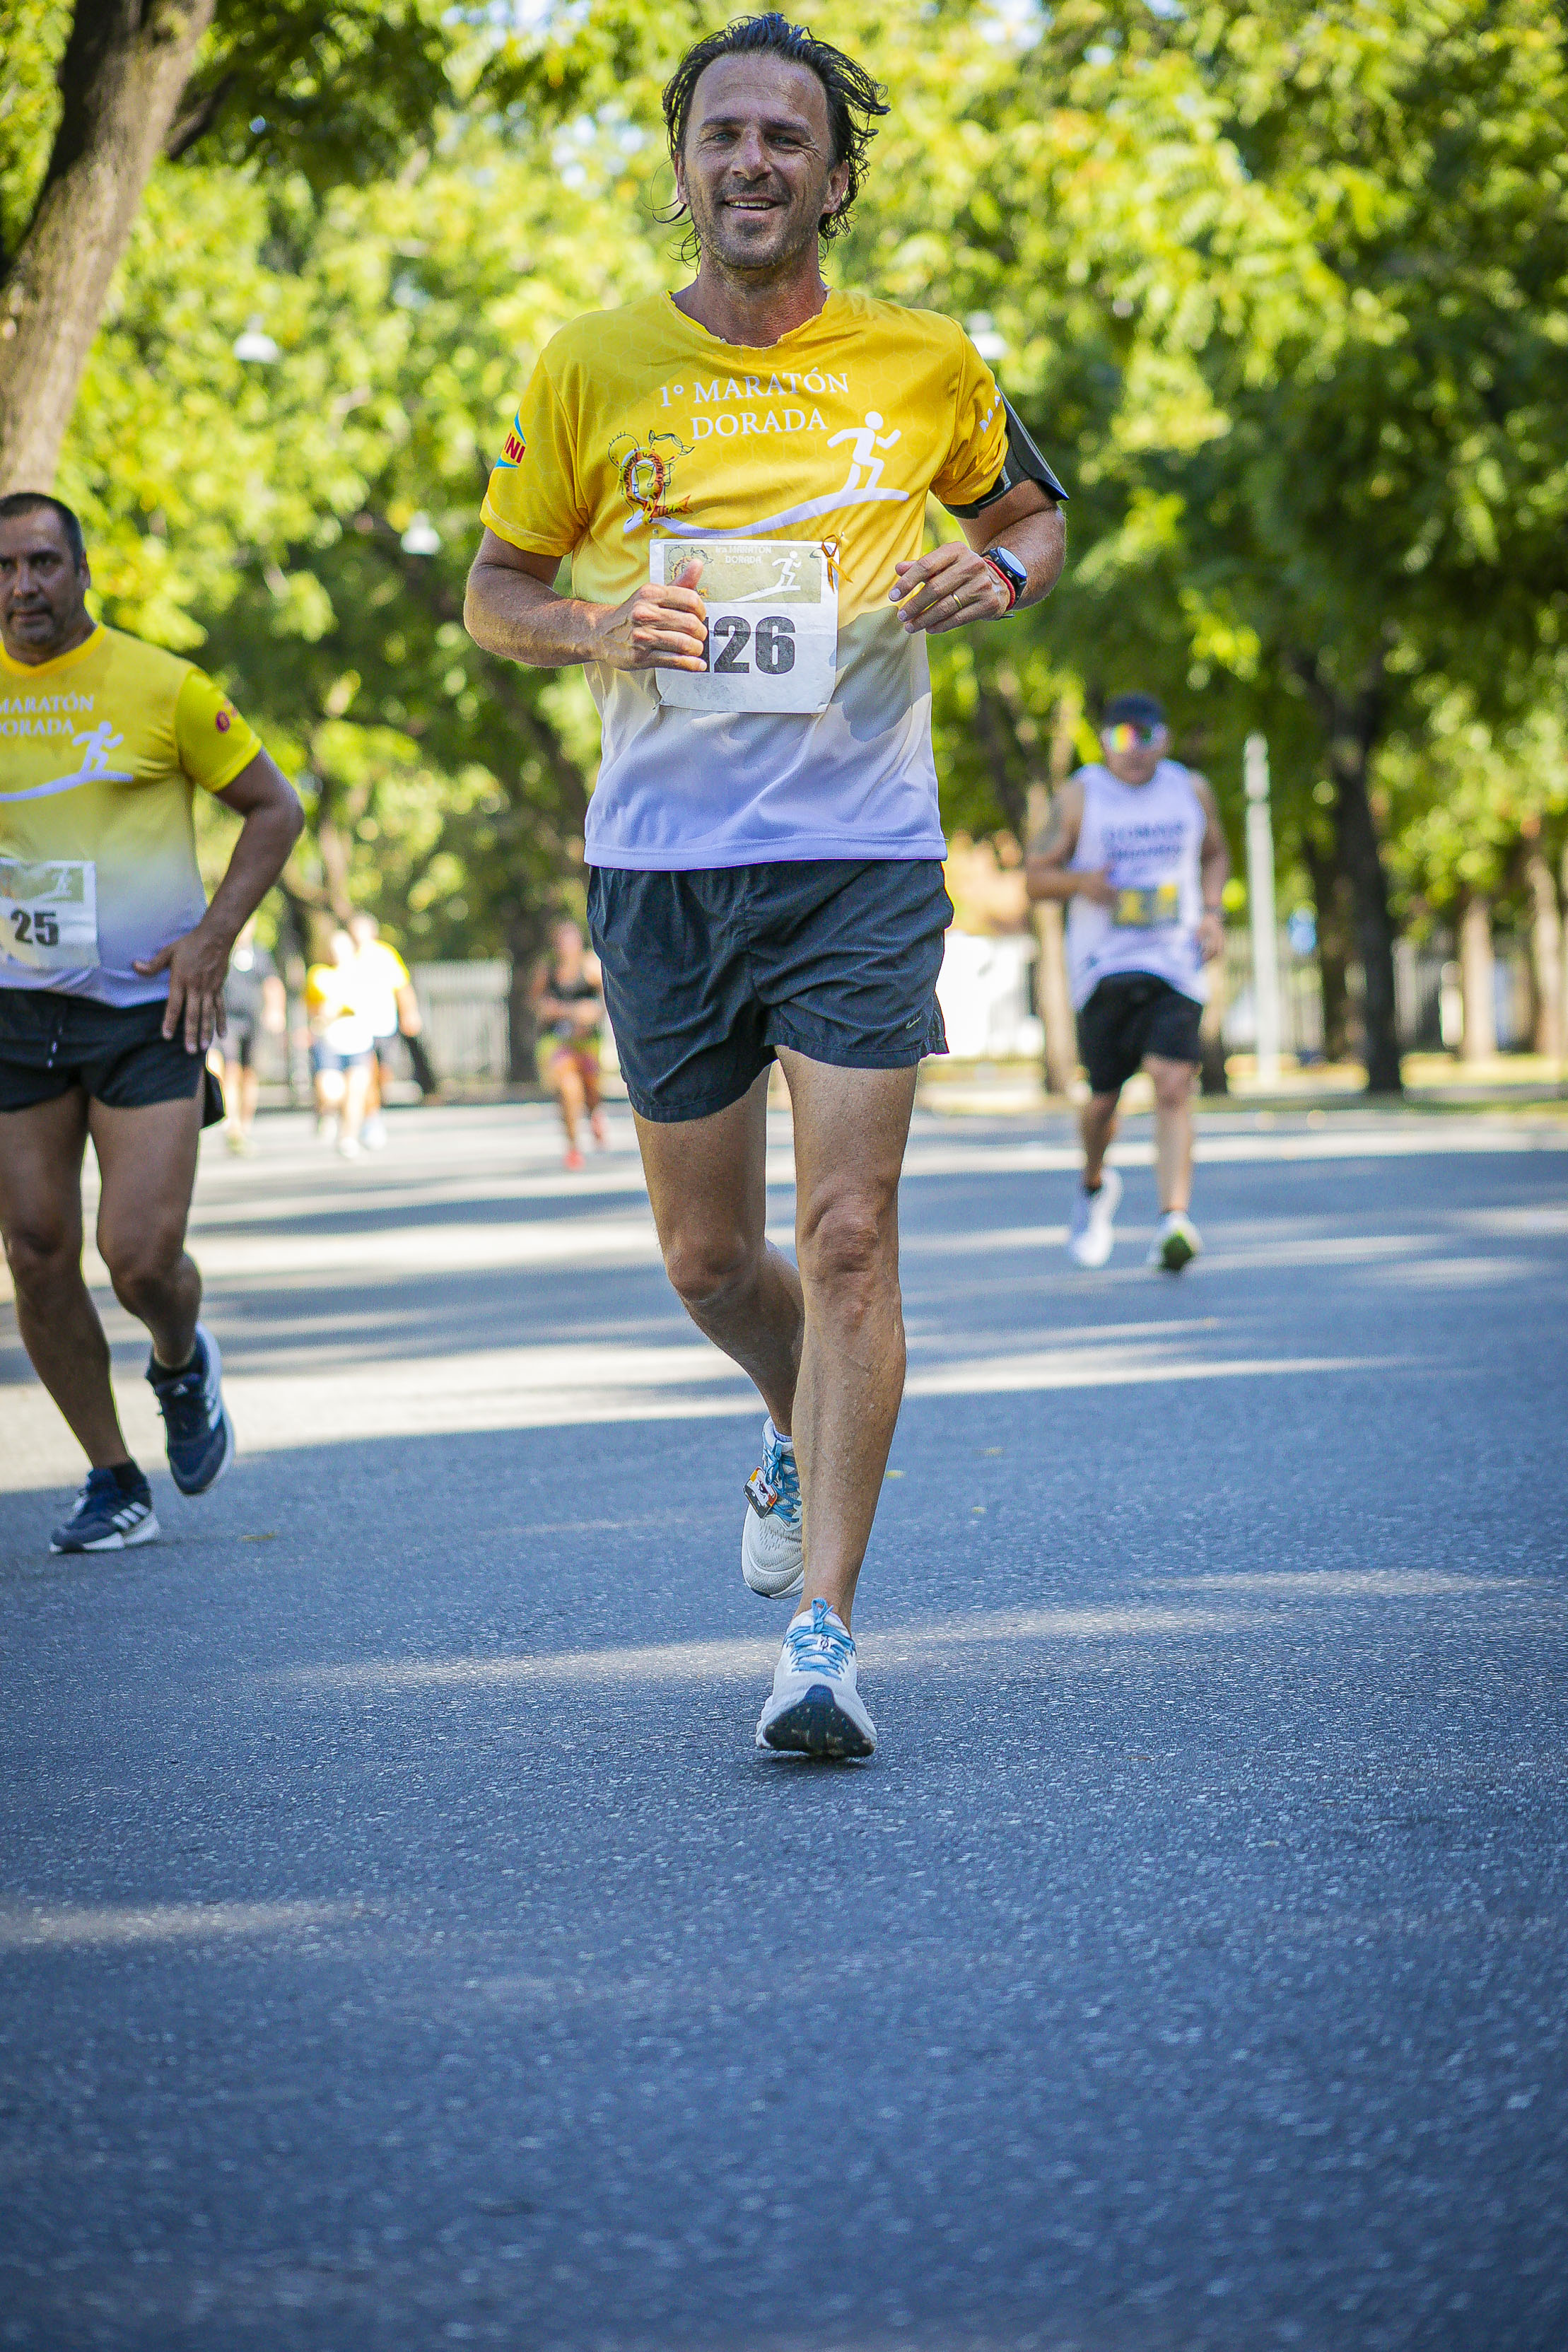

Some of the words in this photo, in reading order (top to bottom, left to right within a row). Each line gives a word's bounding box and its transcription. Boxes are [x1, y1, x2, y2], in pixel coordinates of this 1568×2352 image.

[693, 366, 848, 404] MARATÓN
[690, 407, 829, 440] DORADA
[725, 555, 762, 565] DORADA
[0, 718, 74, 737] ORADA
